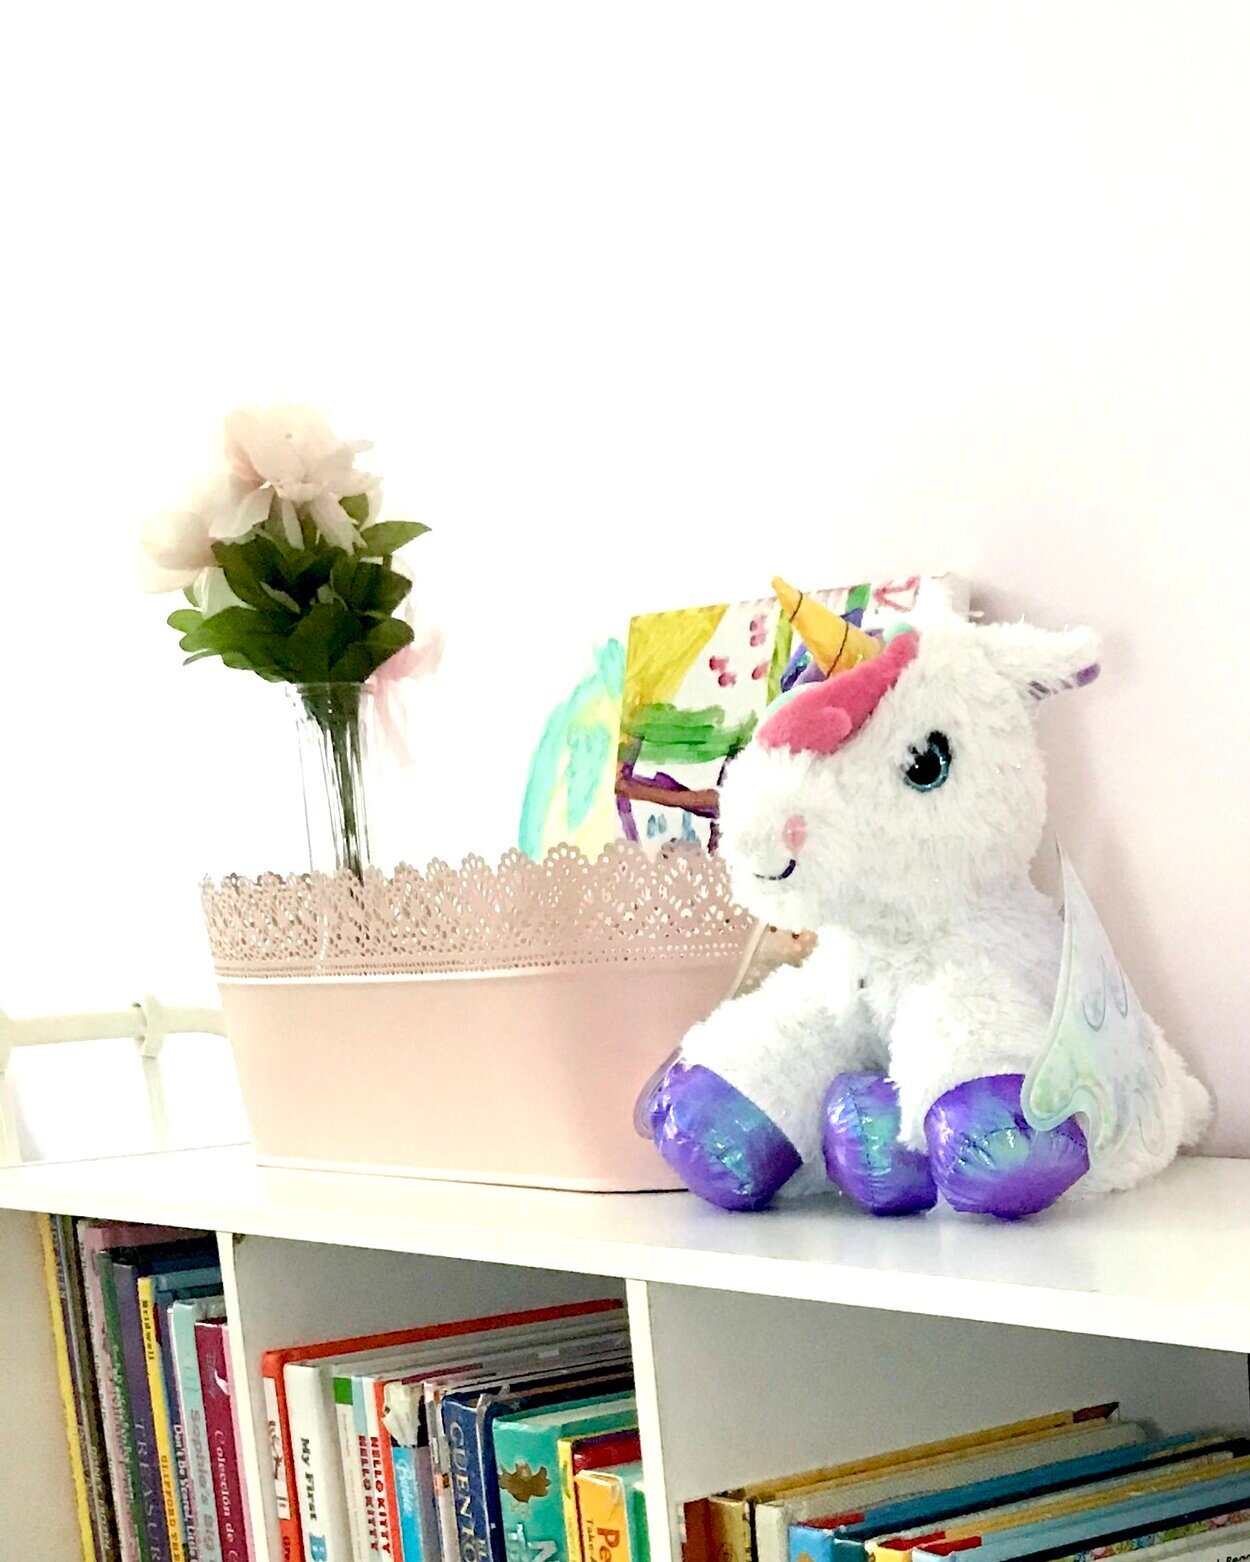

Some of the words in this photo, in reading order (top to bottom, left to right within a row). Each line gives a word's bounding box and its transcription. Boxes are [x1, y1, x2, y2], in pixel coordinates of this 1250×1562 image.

[300, 1437, 311, 1466] My
[305, 1472, 317, 1521] First
[358, 1435, 372, 1490] HELLO
[365, 1496, 379, 1552] KITTY
[370, 1436, 384, 1493] HELLO
[377, 1497, 391, 1553] KITTY
[171, 1529, 181, 1562] THE
